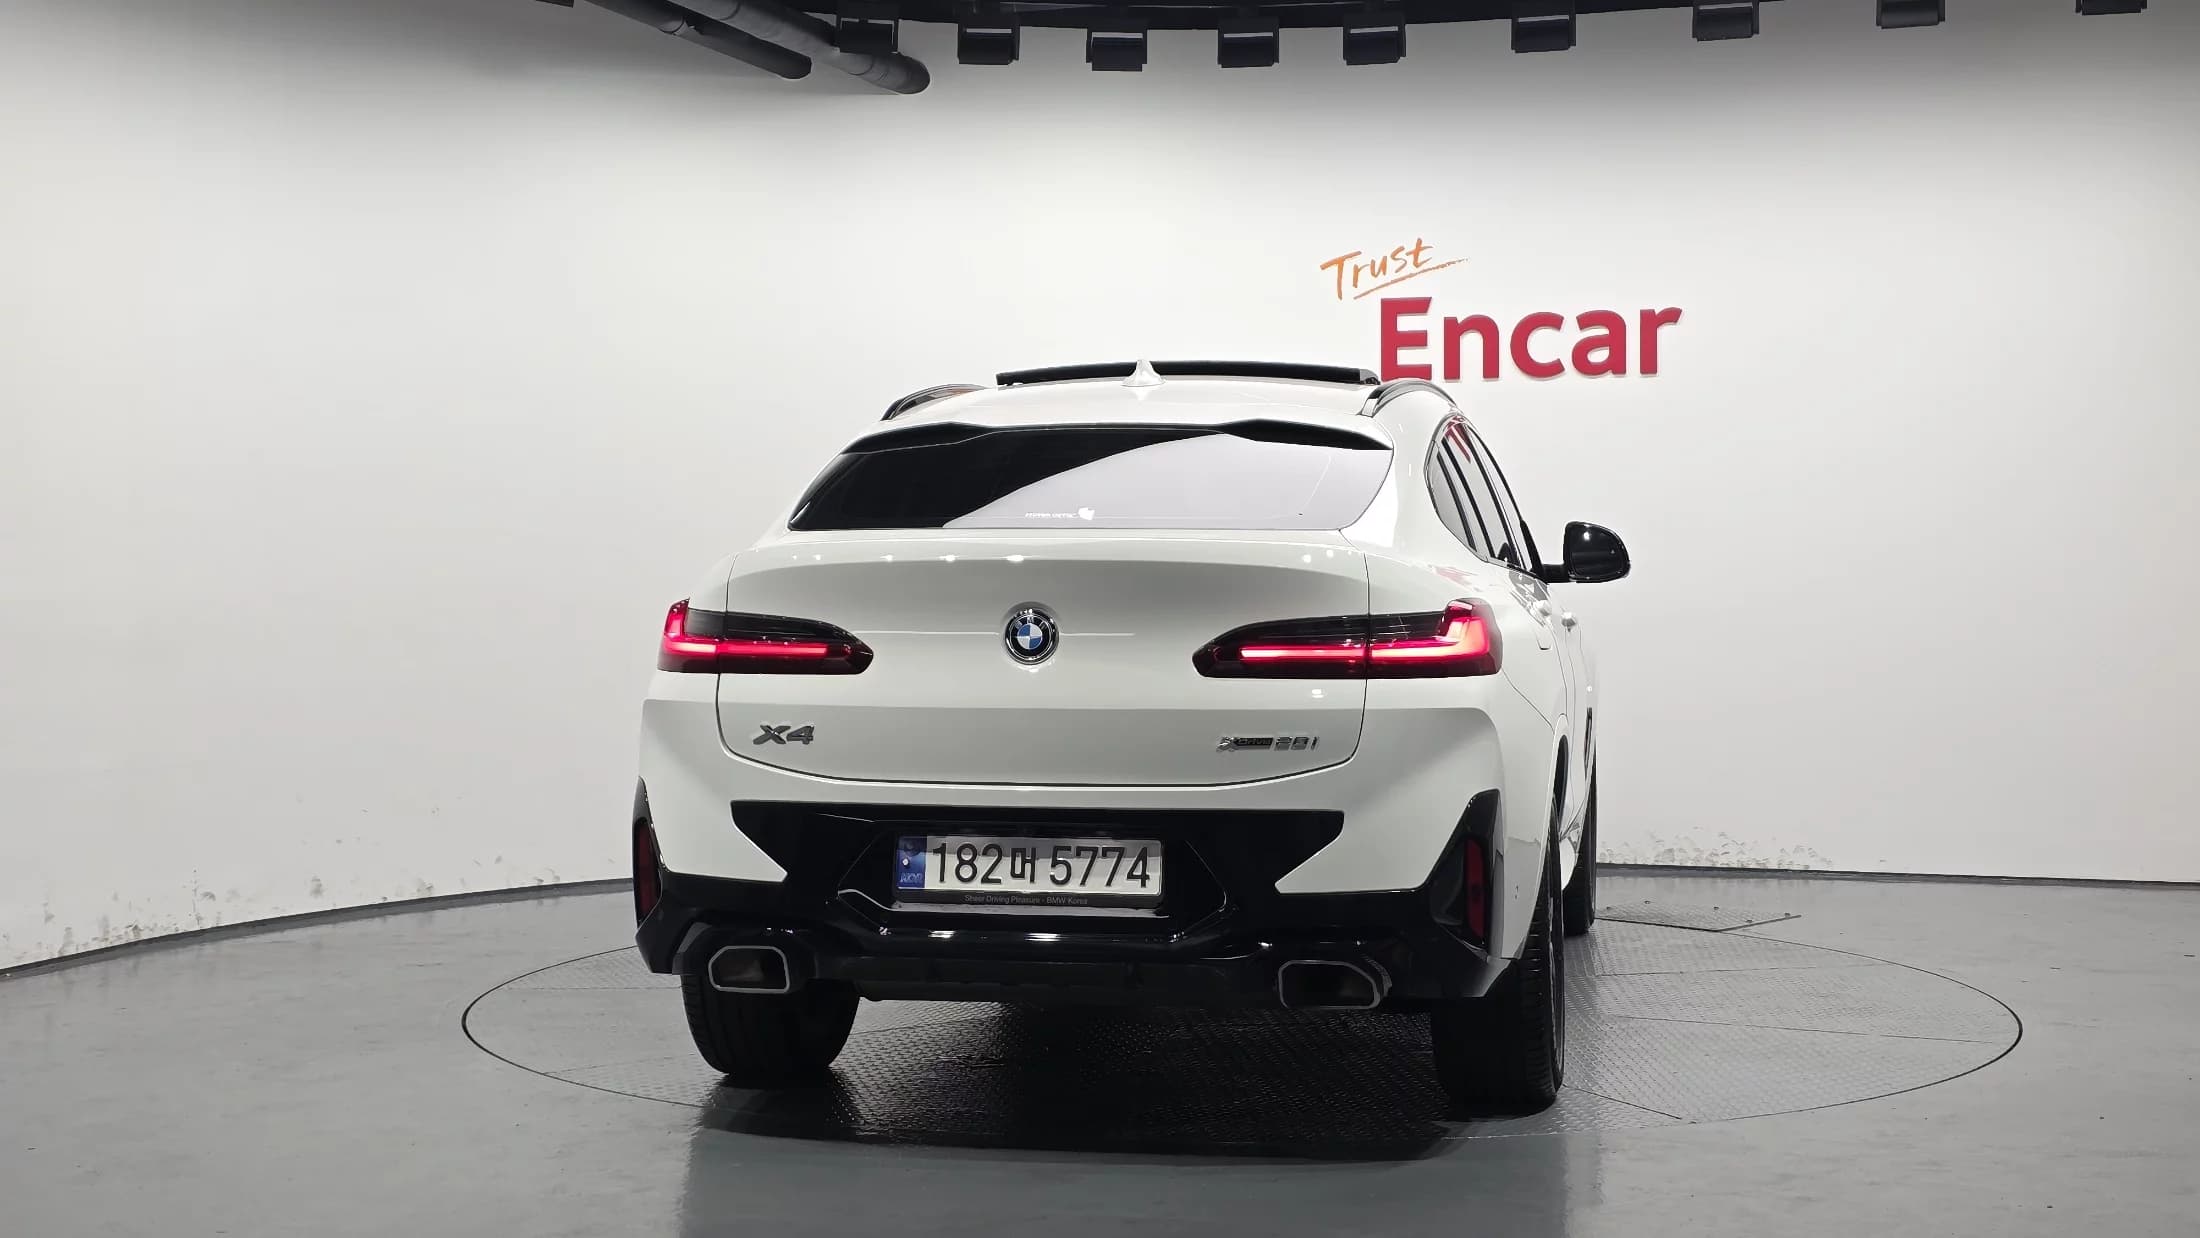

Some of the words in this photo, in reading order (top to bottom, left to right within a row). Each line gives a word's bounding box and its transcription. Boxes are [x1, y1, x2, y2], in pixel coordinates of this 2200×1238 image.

[1319, 237, 1433, 300] Trust
[1380, 296, 1682, 382] Encar
[752, 724, 815, 745] X4
[932, 842, 1036, 884] 182머
[1049, 845, 1151, 888] 5774
[986, 895, 1010, 905] Driving
[1046, 896, 1066, 904] BMW
